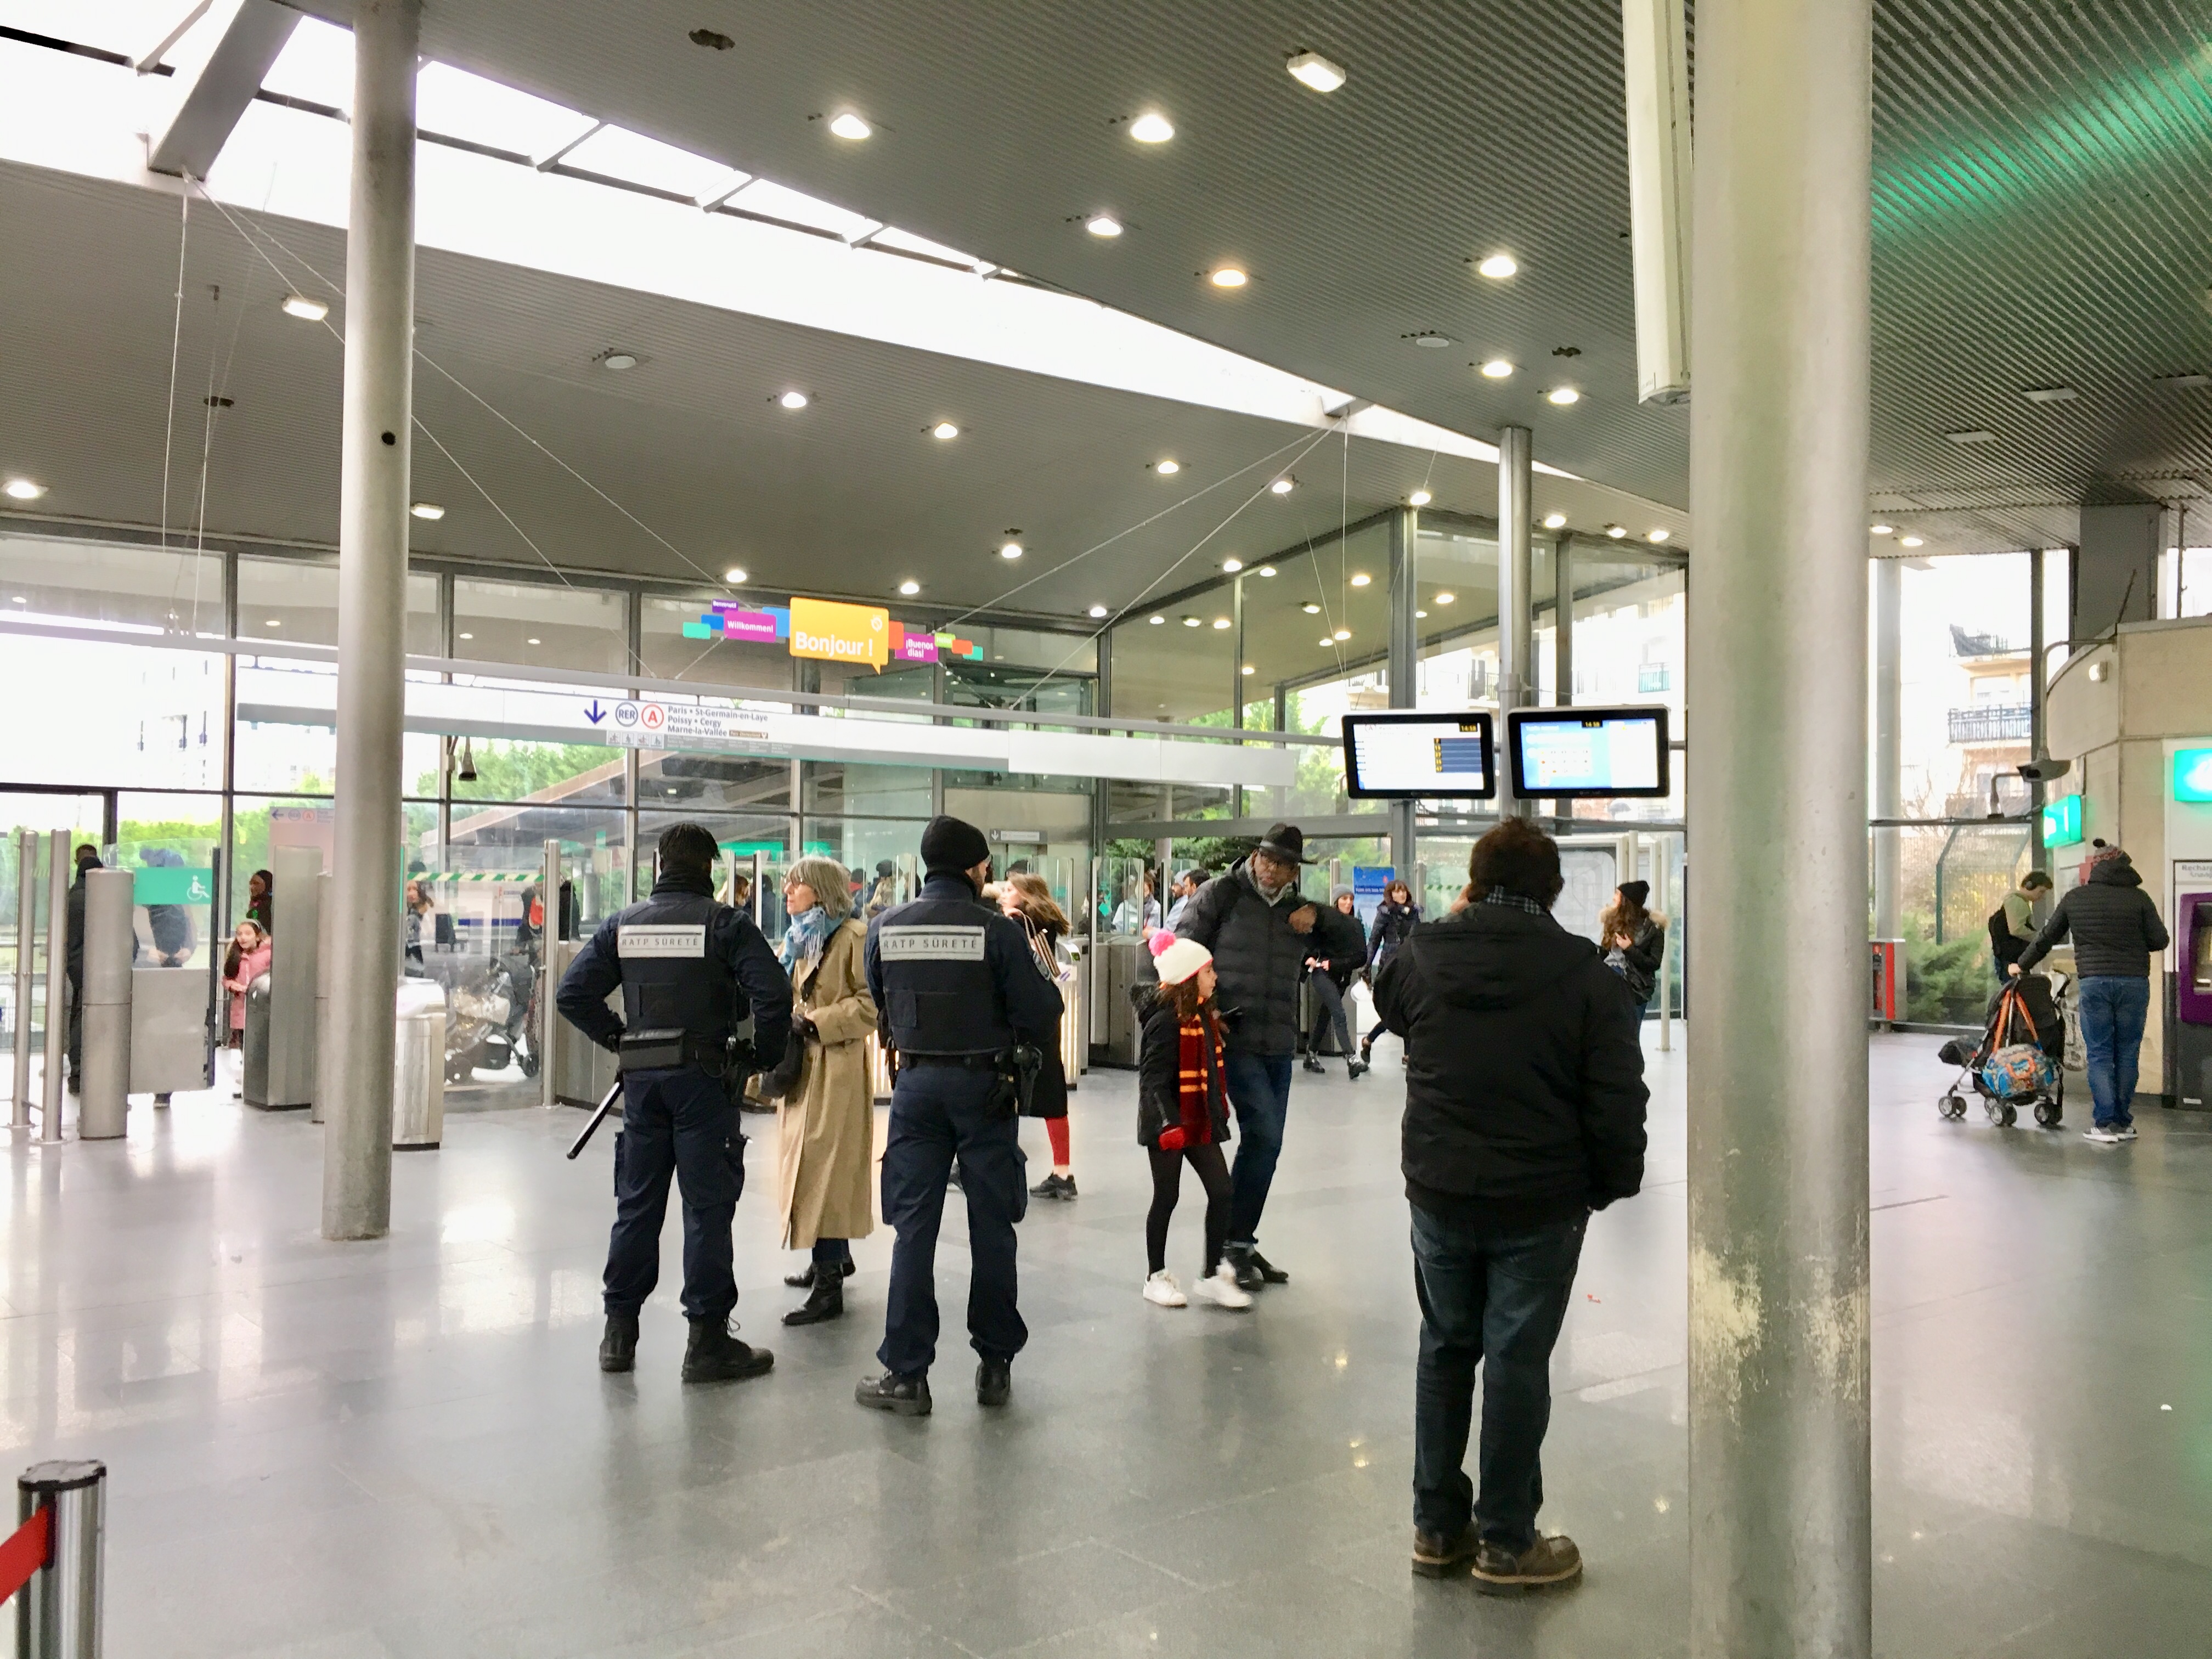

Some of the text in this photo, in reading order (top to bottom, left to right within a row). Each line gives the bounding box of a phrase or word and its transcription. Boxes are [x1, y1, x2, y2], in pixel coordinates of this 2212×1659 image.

[727, 620, 774, 633] Willkommen!
[795, 631, 864, 657] Bonjour
[618, 709, 635, 720] RER
[648, 710, 658, 723] A
[668, 705, 768, 723] Paris St-Germain-en-Laye
[668, 715, 721, 728] Poissy Cergy
[668, 724, 727, 737] Marne-la-Vallée
[622, 938, 648, 946] RATP
[883, 939, 915, 949] RATP
